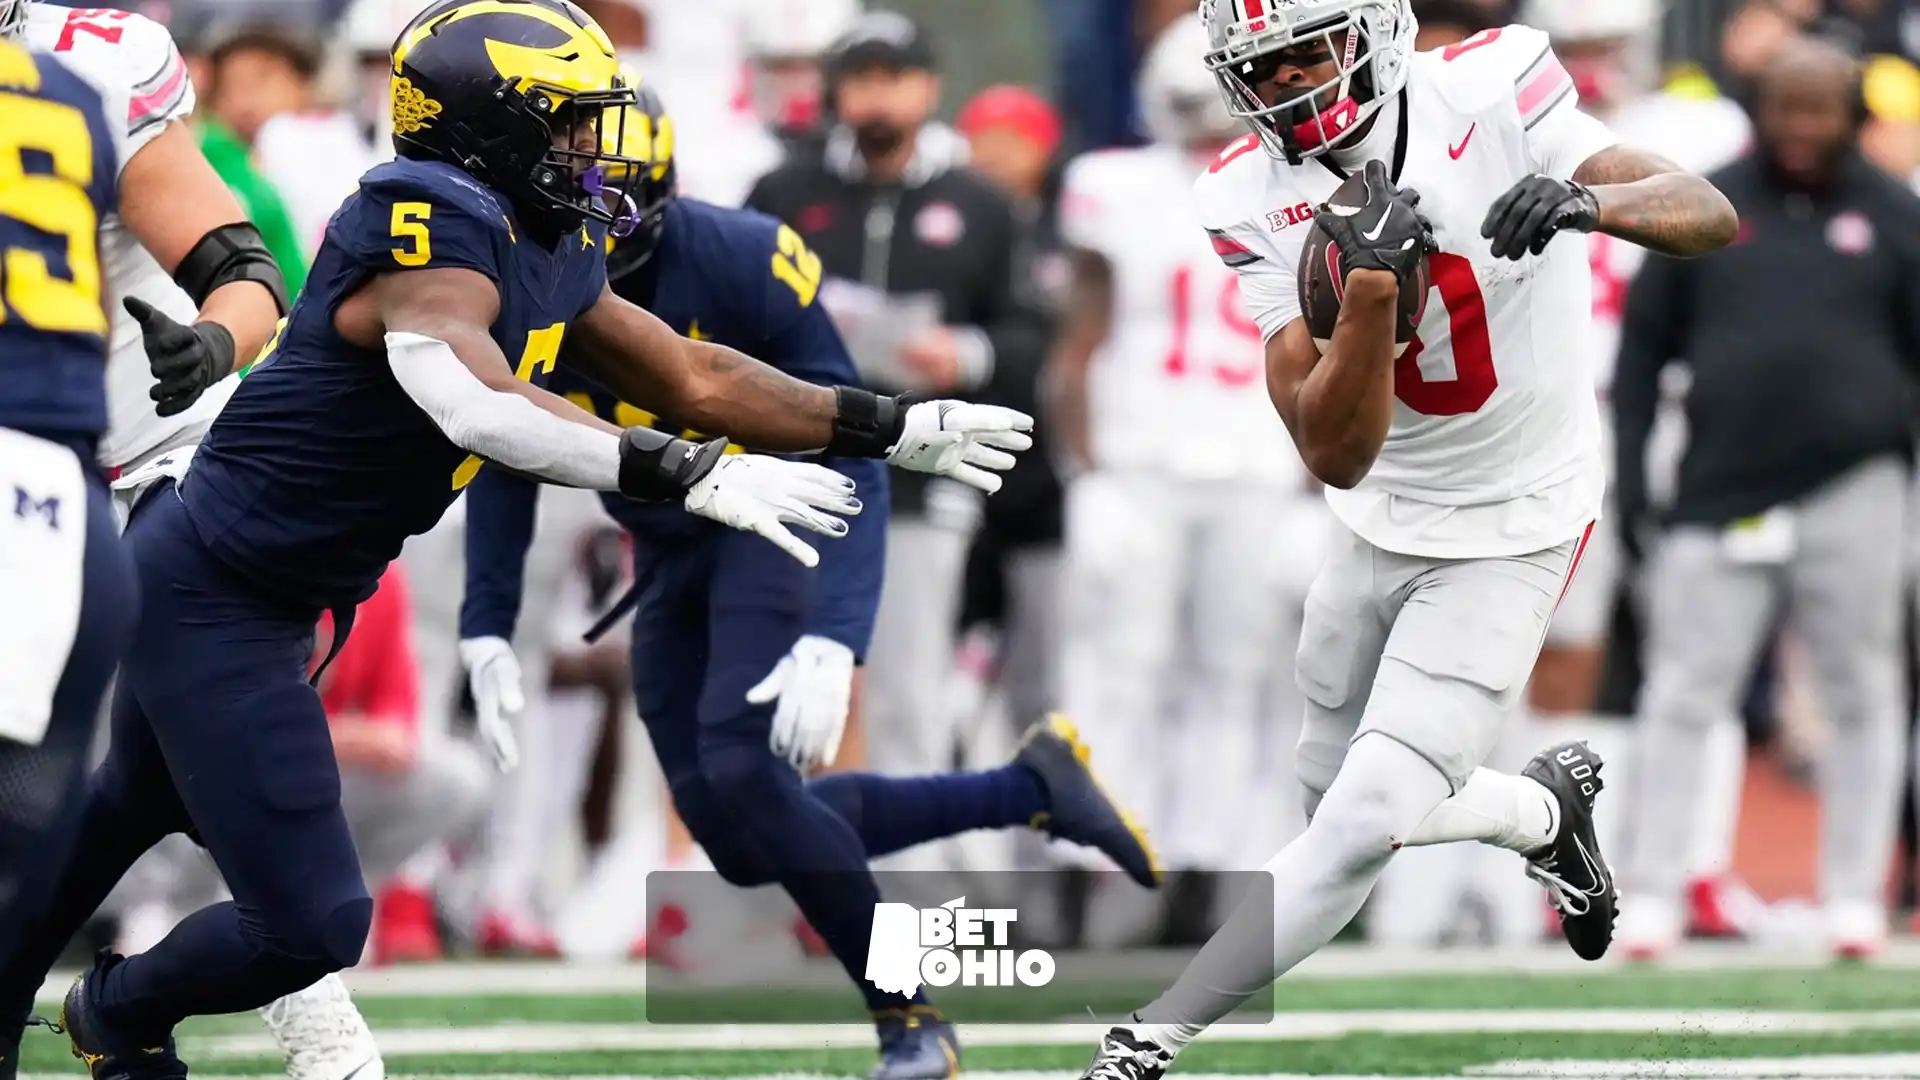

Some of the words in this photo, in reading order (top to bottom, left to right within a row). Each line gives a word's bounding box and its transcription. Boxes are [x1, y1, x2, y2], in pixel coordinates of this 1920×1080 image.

[390, 202, 432, 266] 5
[771, 223, 822, 307] 12
[1394, 251, 1499, 417] 0
[14, 486, 60, 530] M
